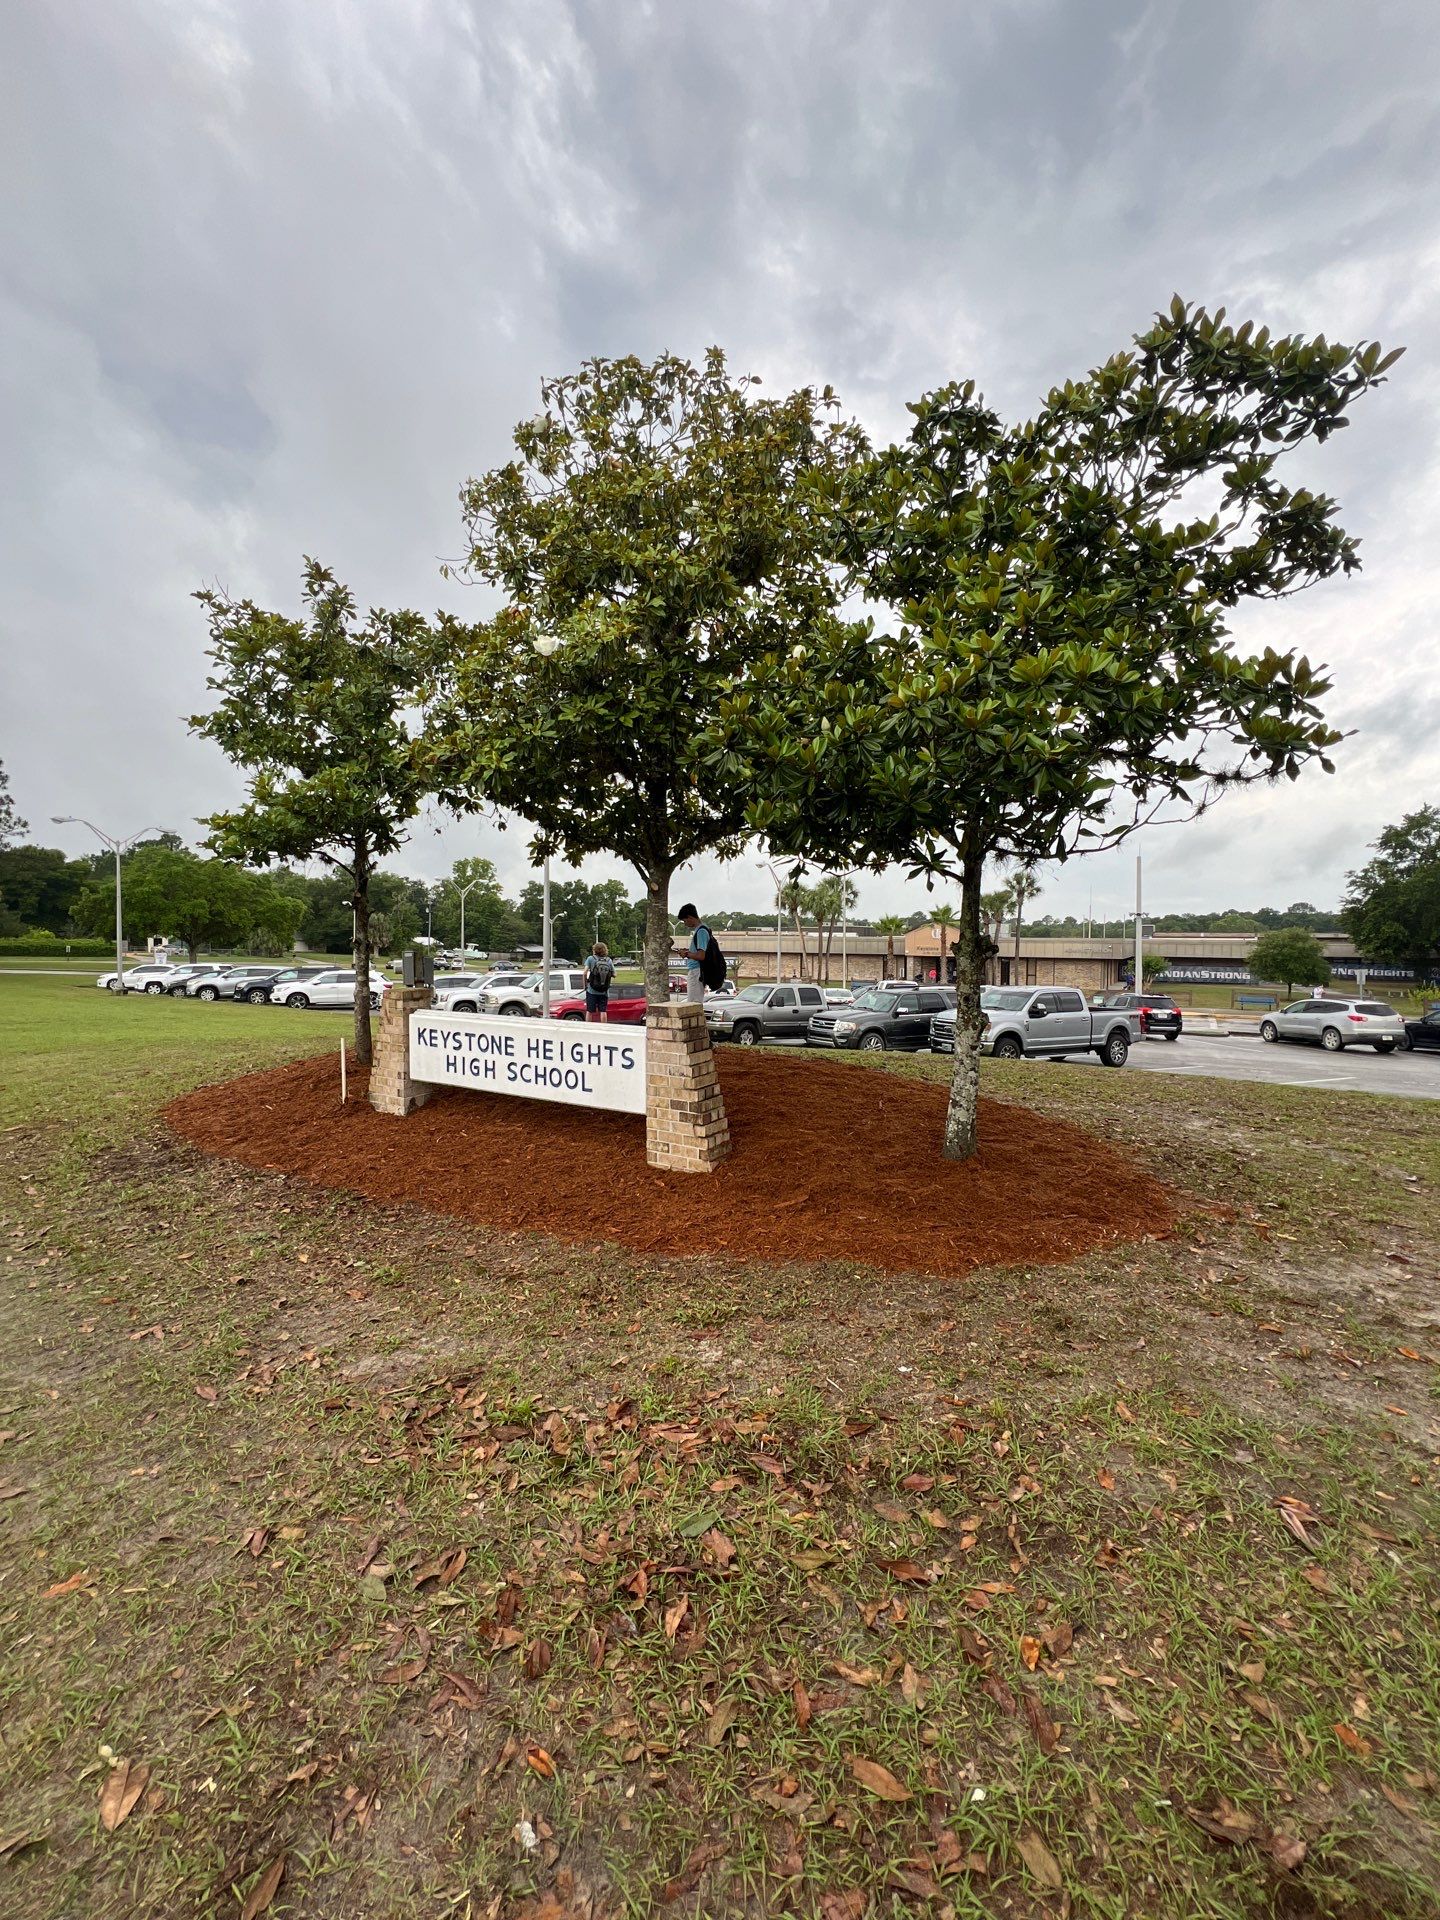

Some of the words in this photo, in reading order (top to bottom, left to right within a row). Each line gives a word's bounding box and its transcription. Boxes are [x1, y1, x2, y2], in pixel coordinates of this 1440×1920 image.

[417, 1027, 515, 1057] KEYSTONE
[527, 1037, 635, 1070] HEIGHTS
[446, 1054, 496, 1080] HIGH
[507, 1061, 593, 1093] SCHOOL
